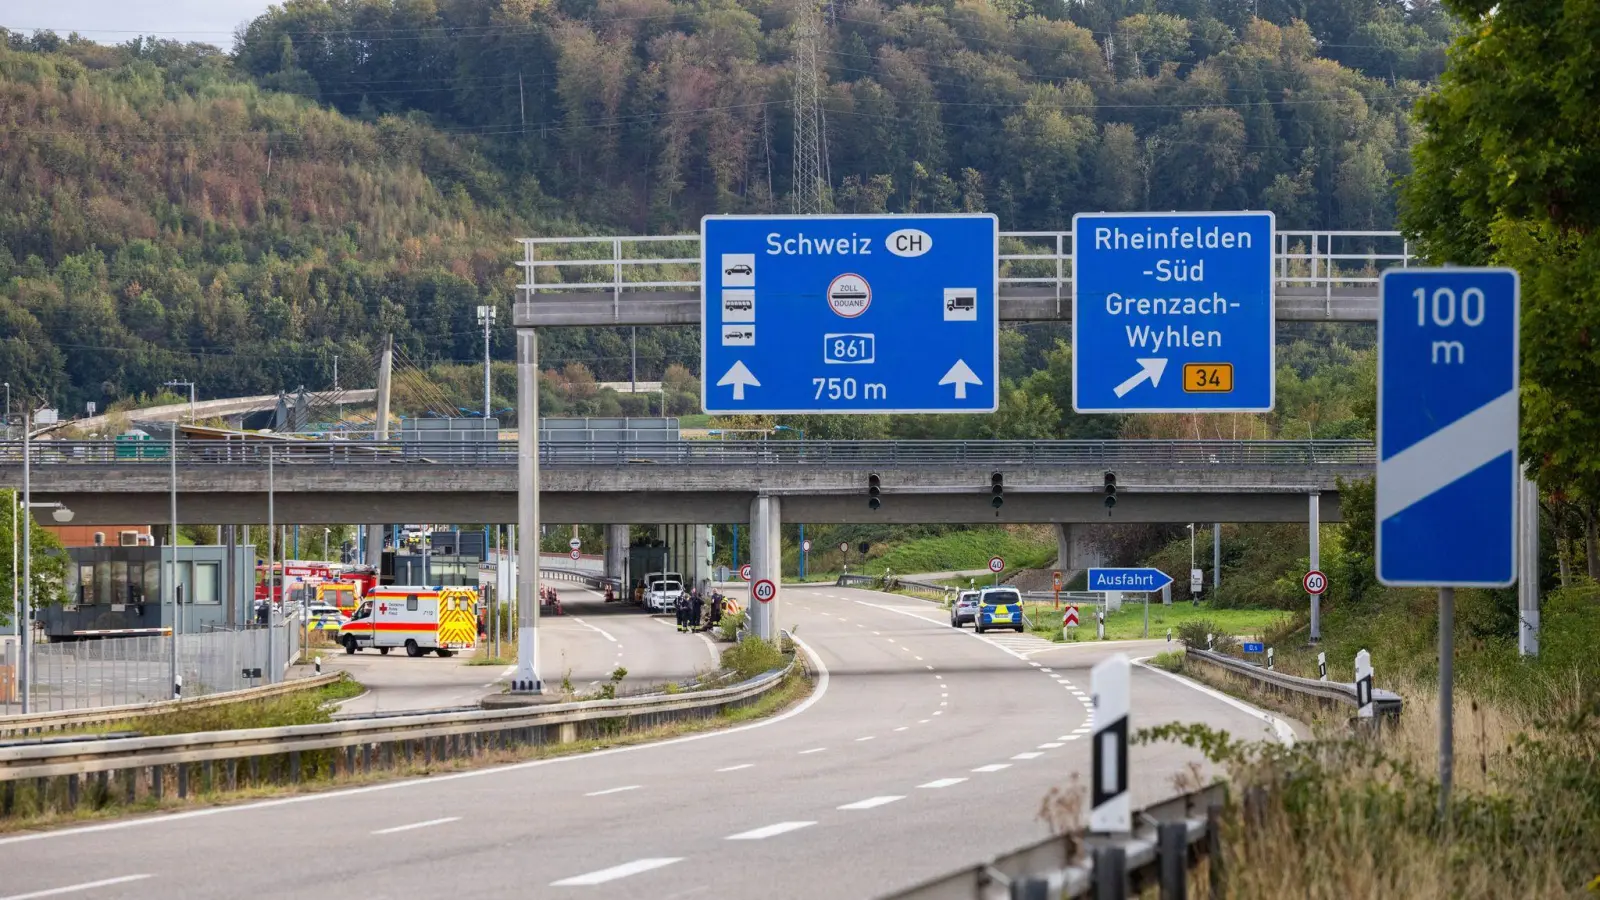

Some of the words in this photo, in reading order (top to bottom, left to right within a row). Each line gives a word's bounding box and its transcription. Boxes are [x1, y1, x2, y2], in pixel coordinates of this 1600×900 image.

[766, 232, 872, 255] Schweiz
[896, 235, 922, 251] CH
[1095, 226, 1252, 250] Rheinfelden
[1143, 259, 1204, 282] -Süd
[840, 284, 858, 292] ZOLL
[1106, 292, 1240, 315] Grenzach-
[1412, 287, 1485, 327] 100
[834, 340, 866, 358] 861
[1125, 325, 1222, 353] Wyhlen
[1431, 340, 1465, 365] m
[812, 378, 857, 400] 750
[864, 383, 887, 400] m
[1196, 369, 1220, 387] 34
[992, 561, 1002, 569] 40
[757, 585, 771, 596] 60
[1096, 573, 1154, 586] Ausfahrt
[1308, 577, 1322, 588] 60
